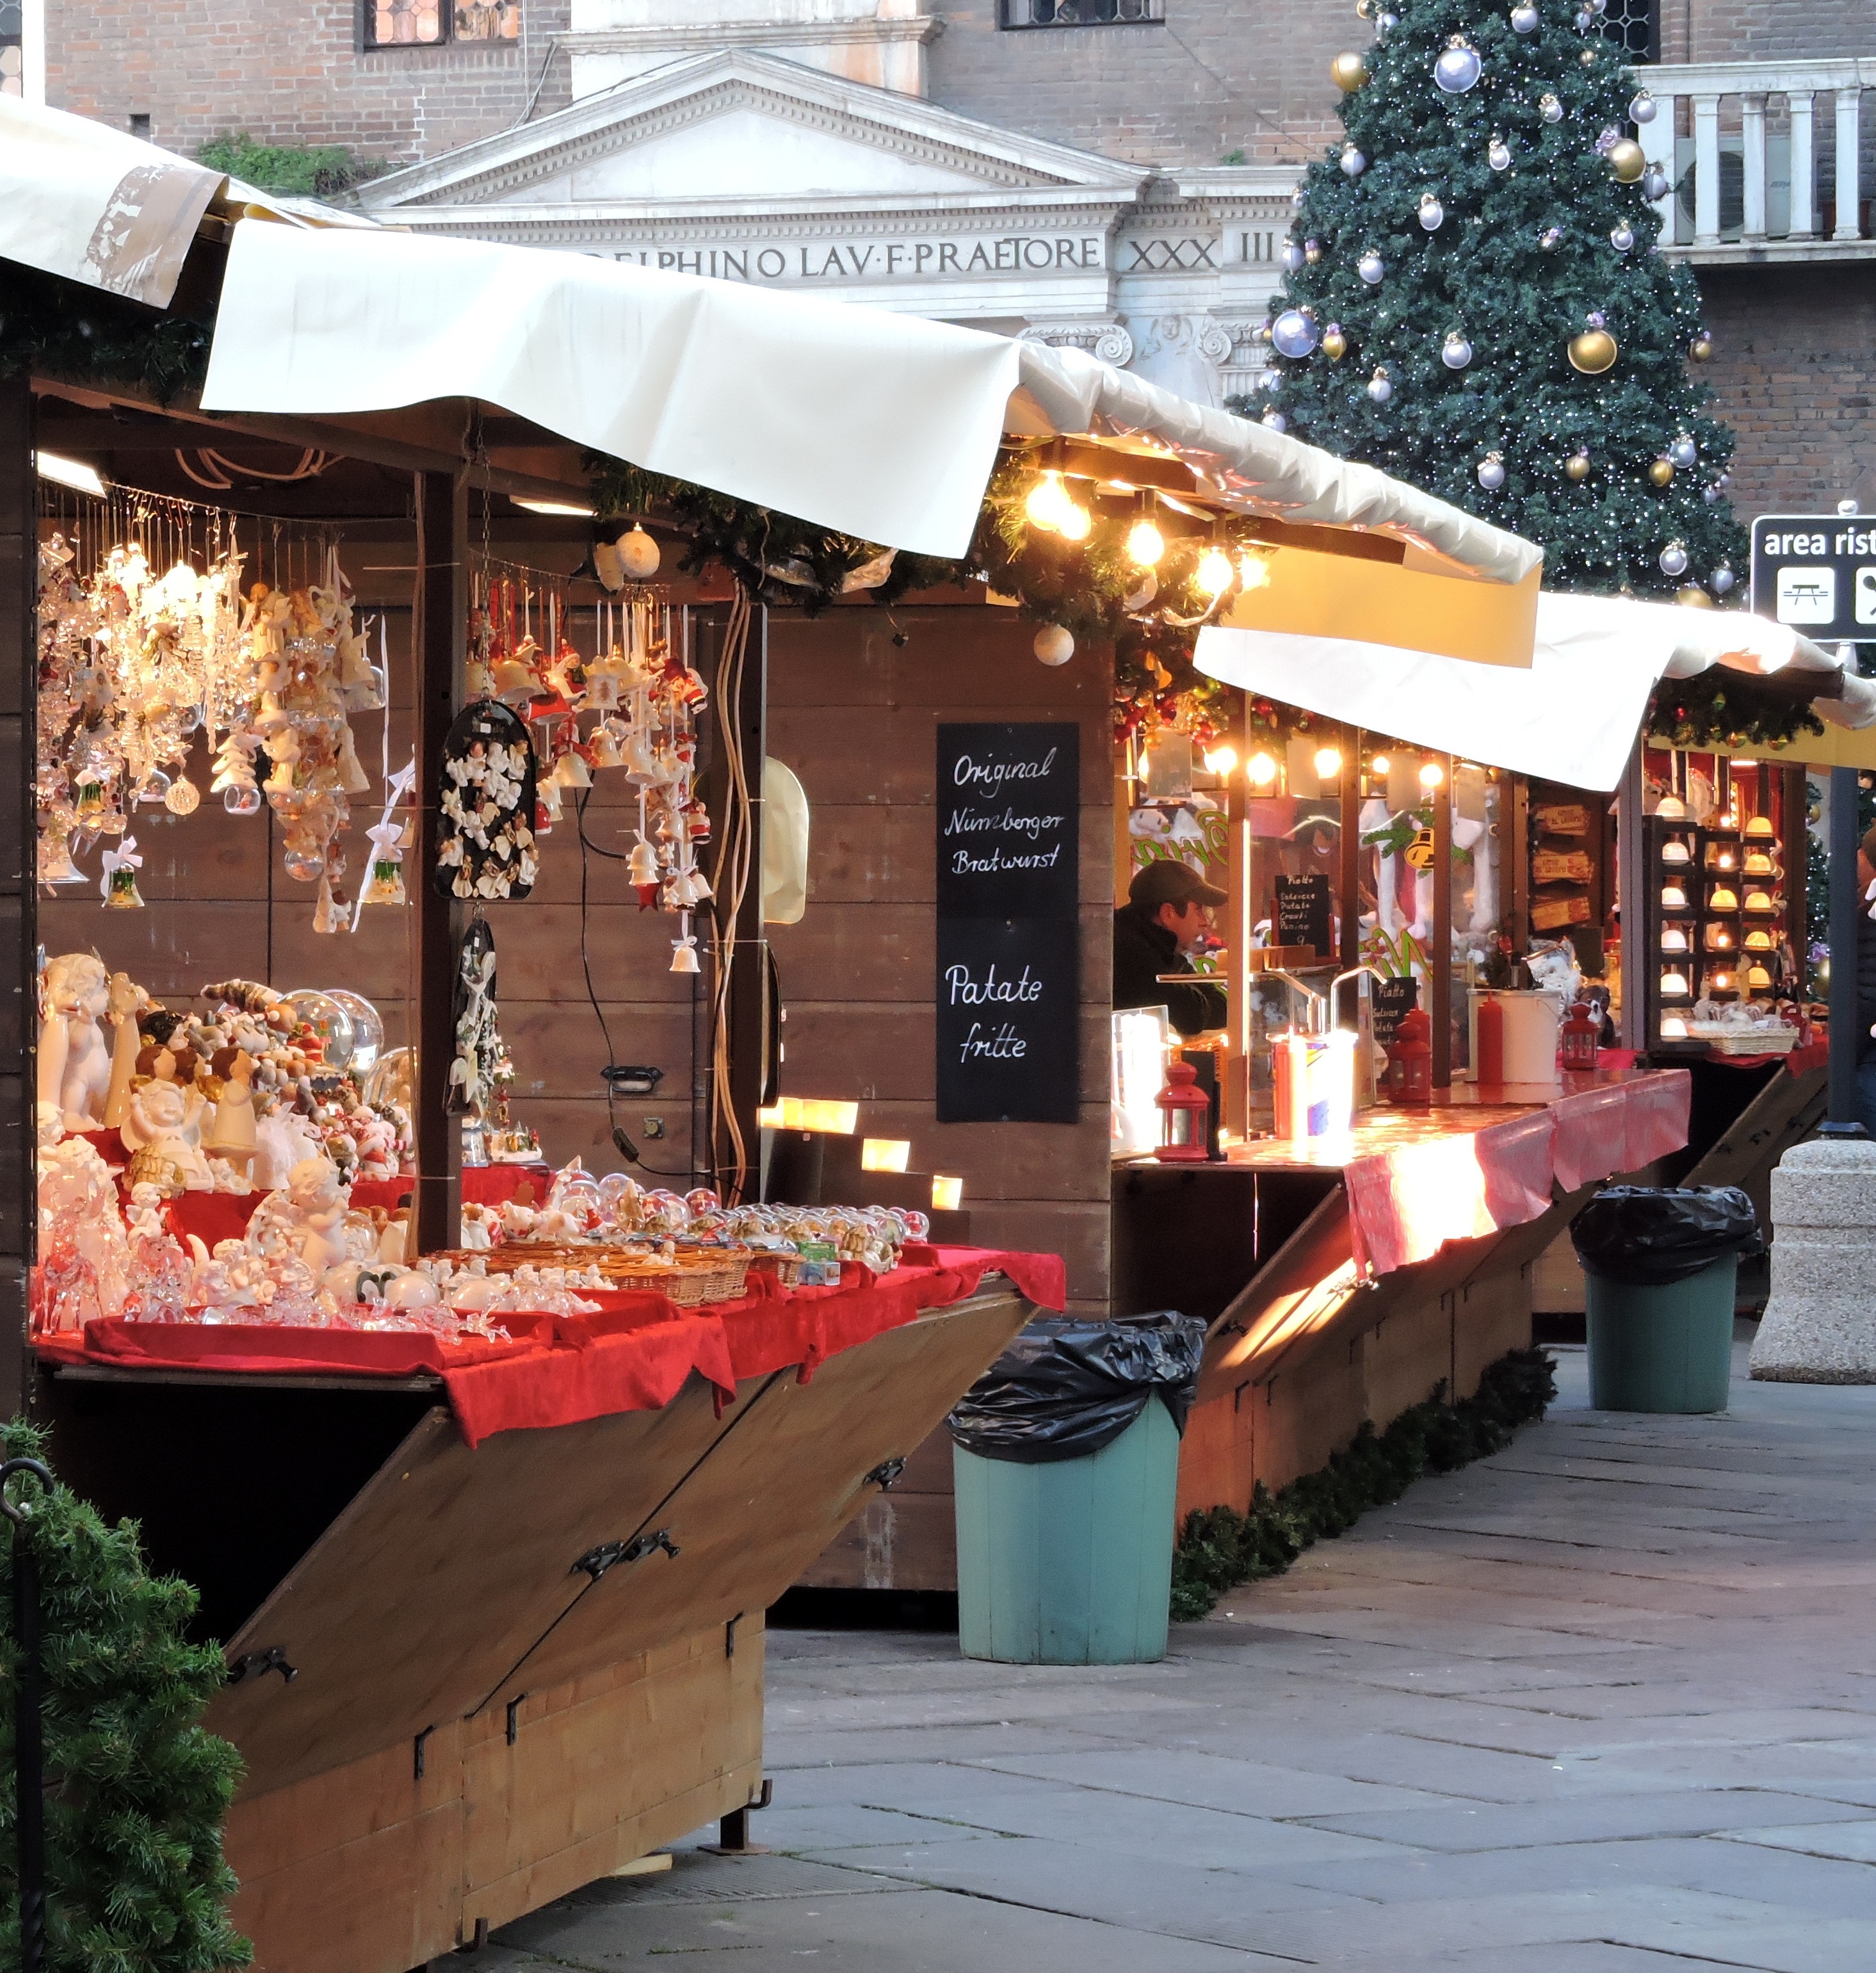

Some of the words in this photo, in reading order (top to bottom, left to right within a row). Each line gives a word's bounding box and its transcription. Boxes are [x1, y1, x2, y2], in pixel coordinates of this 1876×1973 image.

[1764, 533, 1826, 555] area
[1835, 526, 1876, 555] rist
[953, 747, 1058, 798] Original
[951, 843, 1060, 874] Bratwurst
[945, 963, 1042, 1005] Patate
[959, 1021, 1027, 1063] fritte
